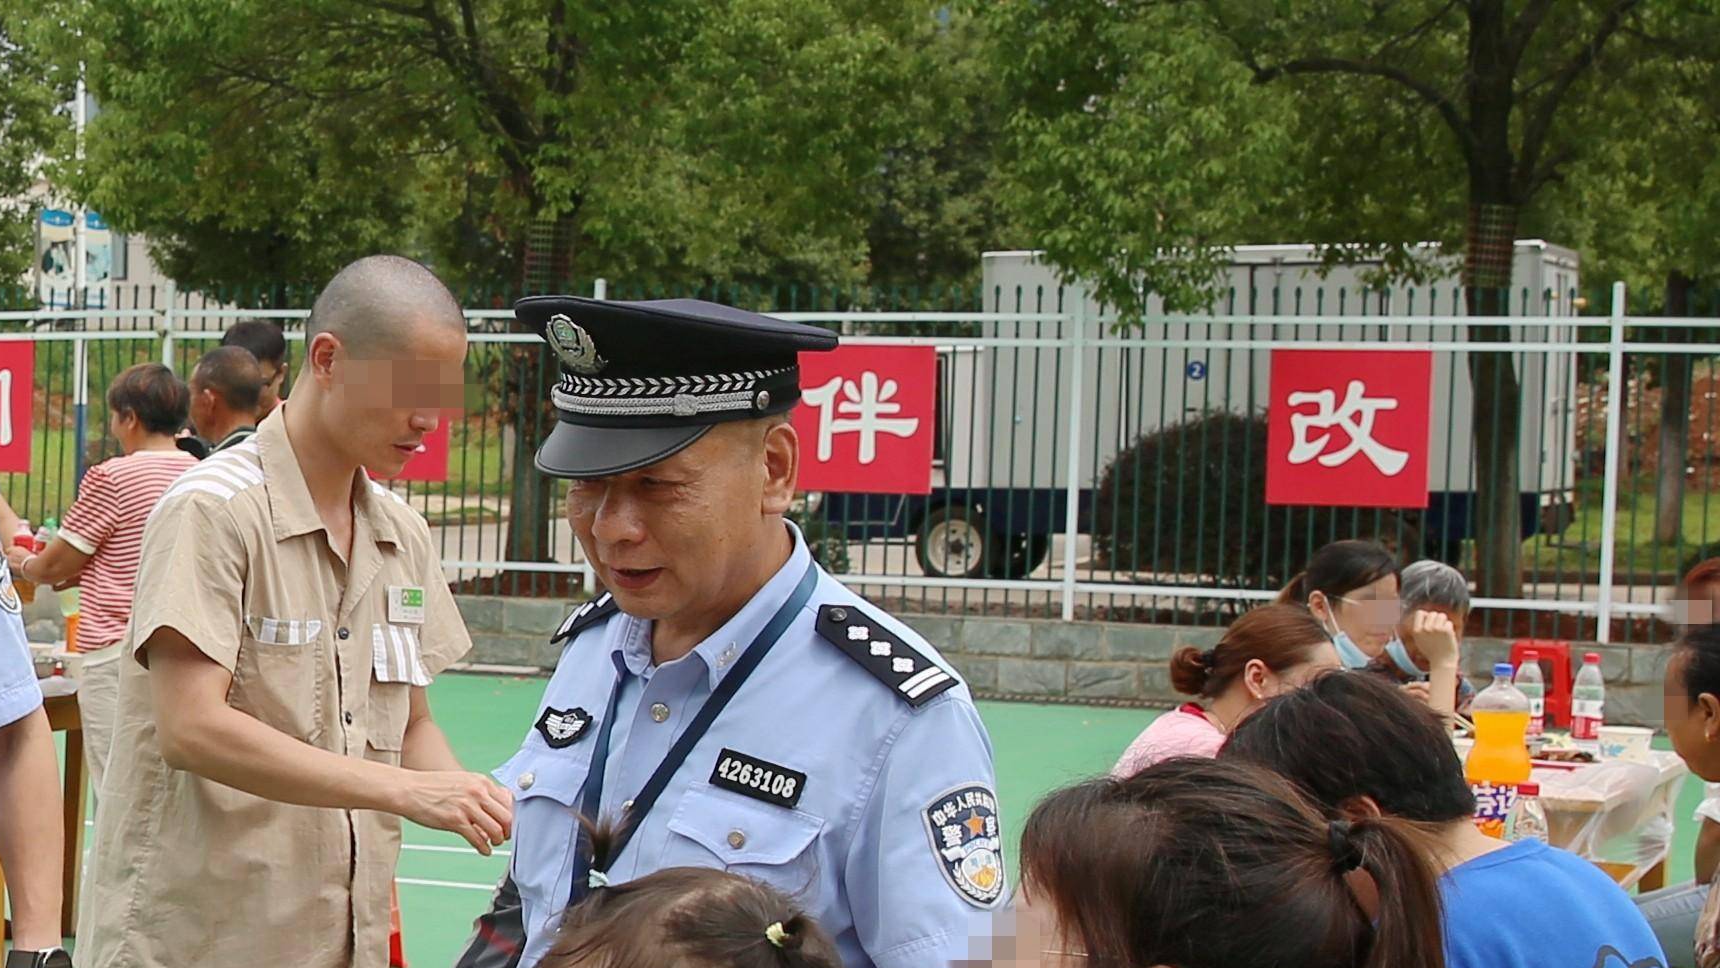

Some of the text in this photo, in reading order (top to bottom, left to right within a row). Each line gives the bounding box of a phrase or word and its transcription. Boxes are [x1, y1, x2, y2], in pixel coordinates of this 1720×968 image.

[1191, 362, 1202, 378] 2
[800, 370, 920, 465] 伴
[1287, 379, 1410, 477] 改
[717, 756, 797, 799] 4263108
